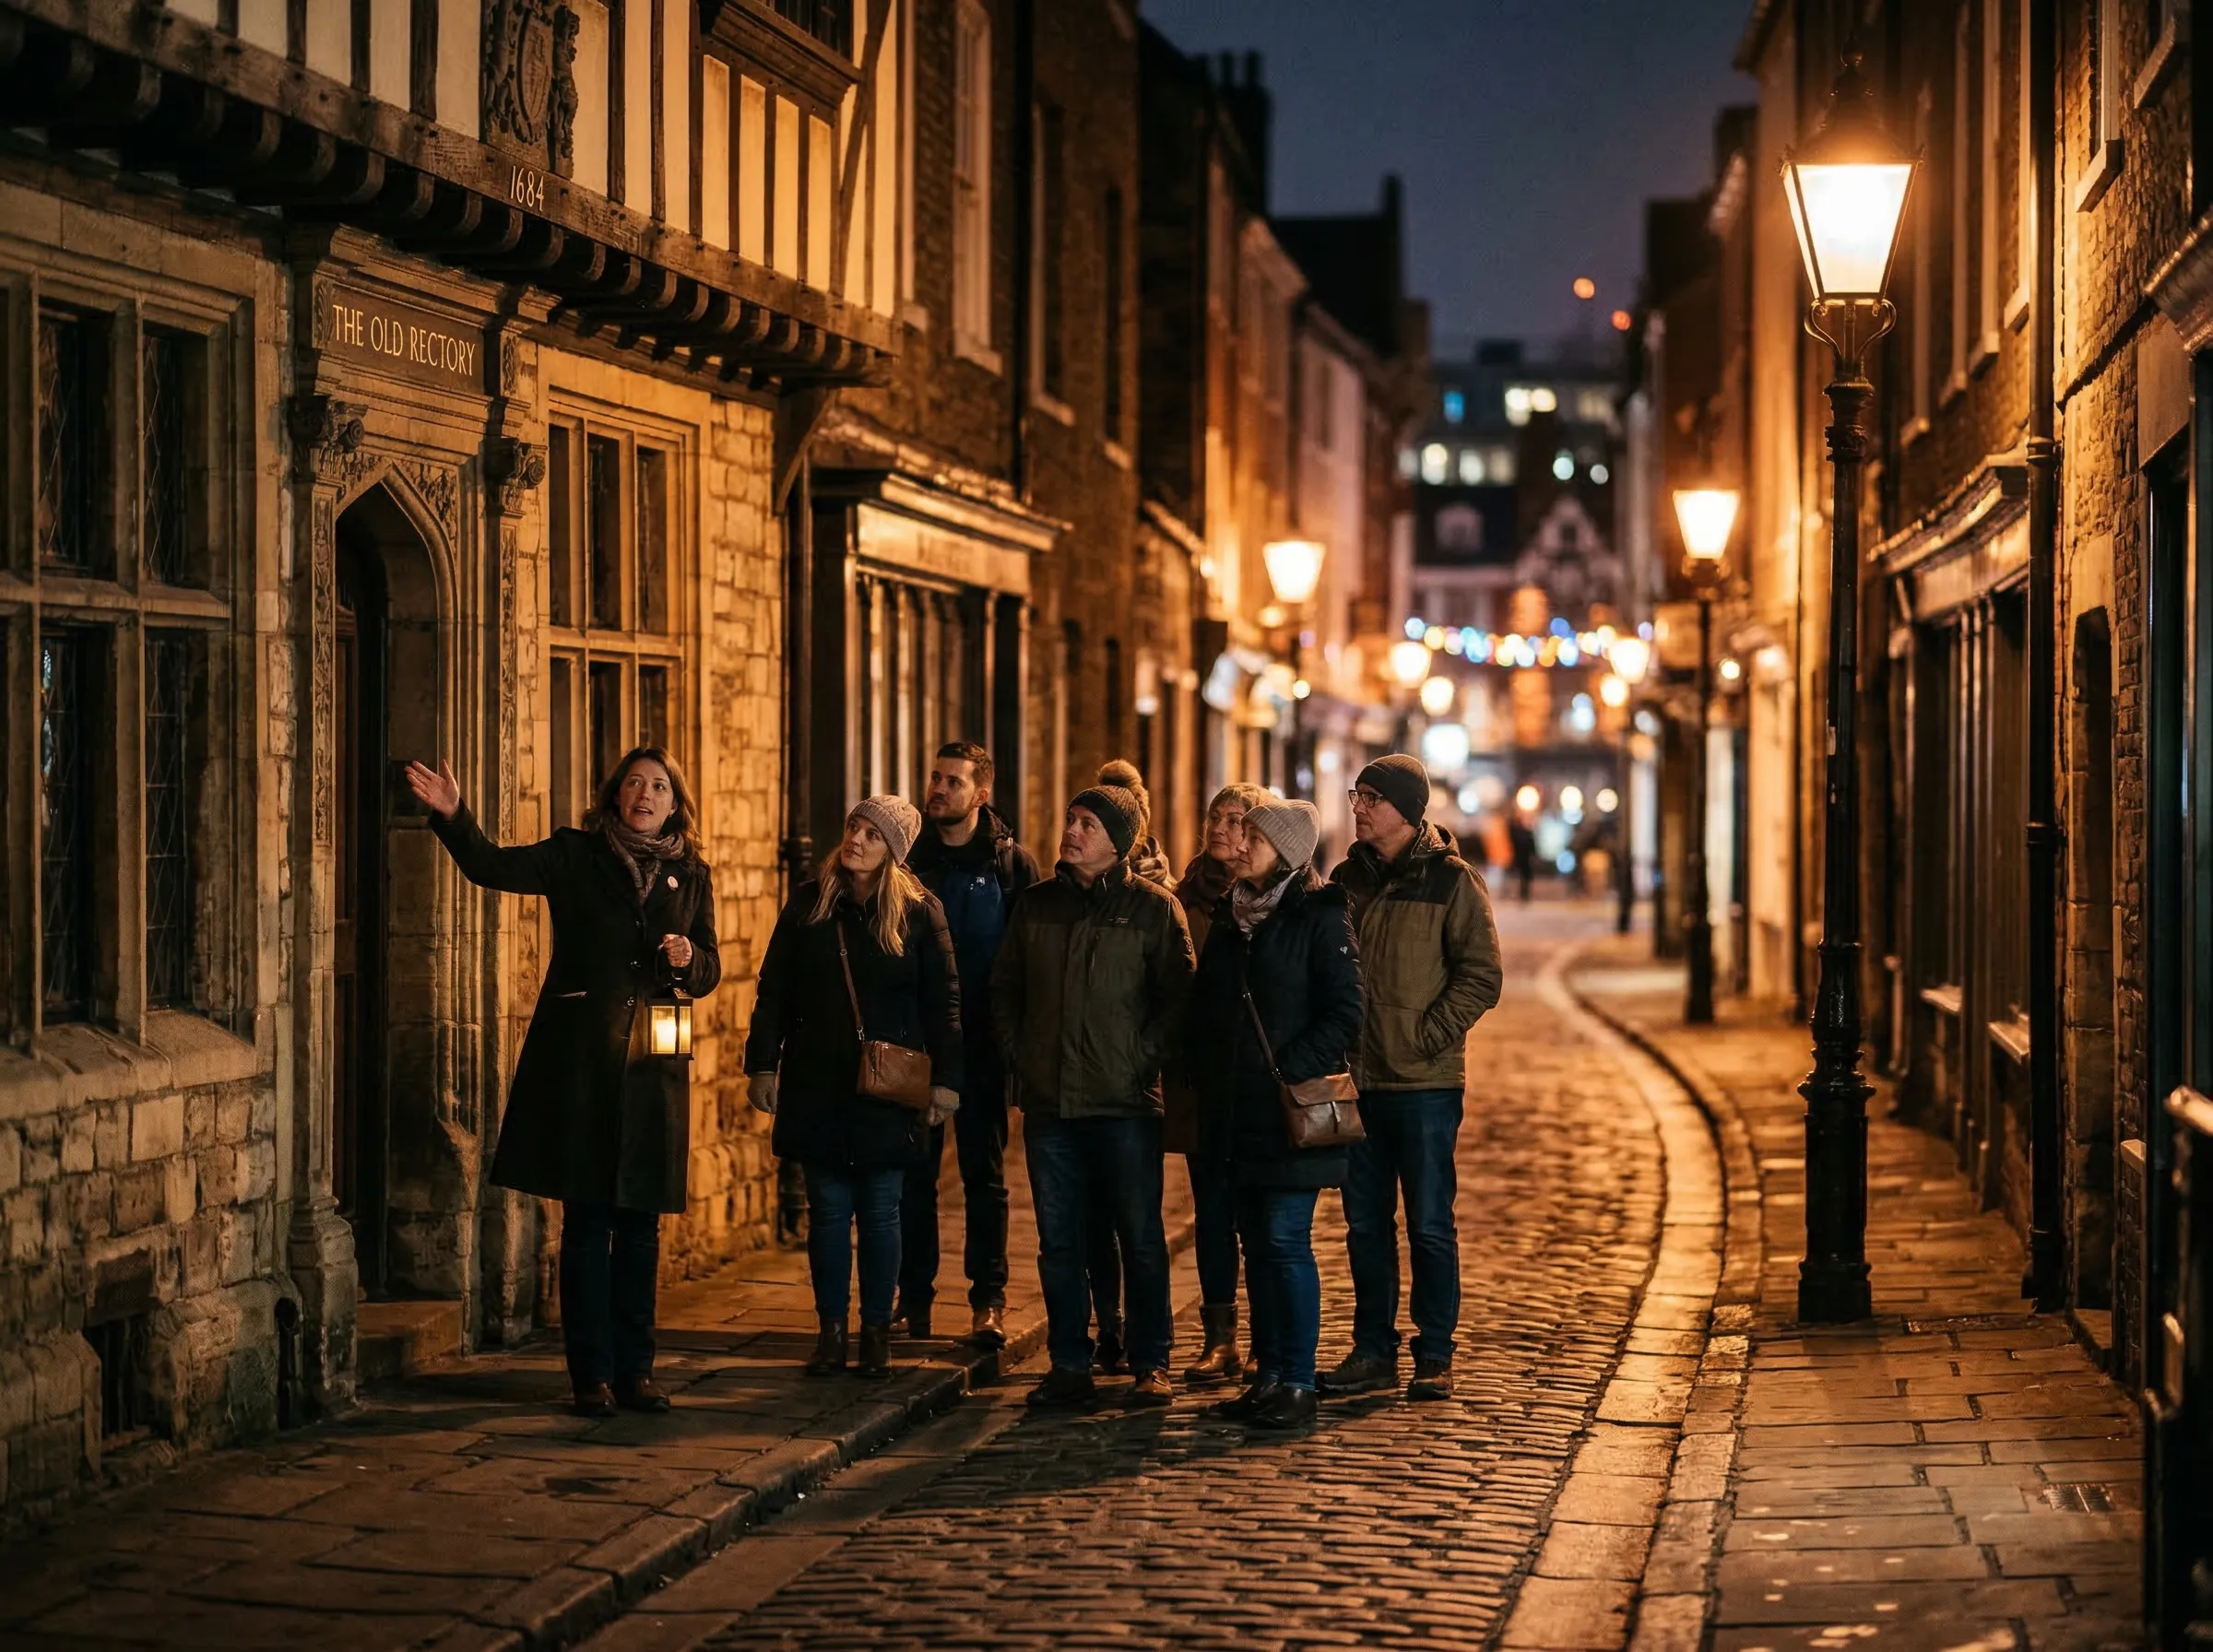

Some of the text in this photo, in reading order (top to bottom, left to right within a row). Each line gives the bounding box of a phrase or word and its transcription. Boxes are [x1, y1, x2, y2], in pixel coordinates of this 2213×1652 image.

[511, 166, 544, 212] 1684
[333, 305, 475, 375] THE OLD RECTORY
